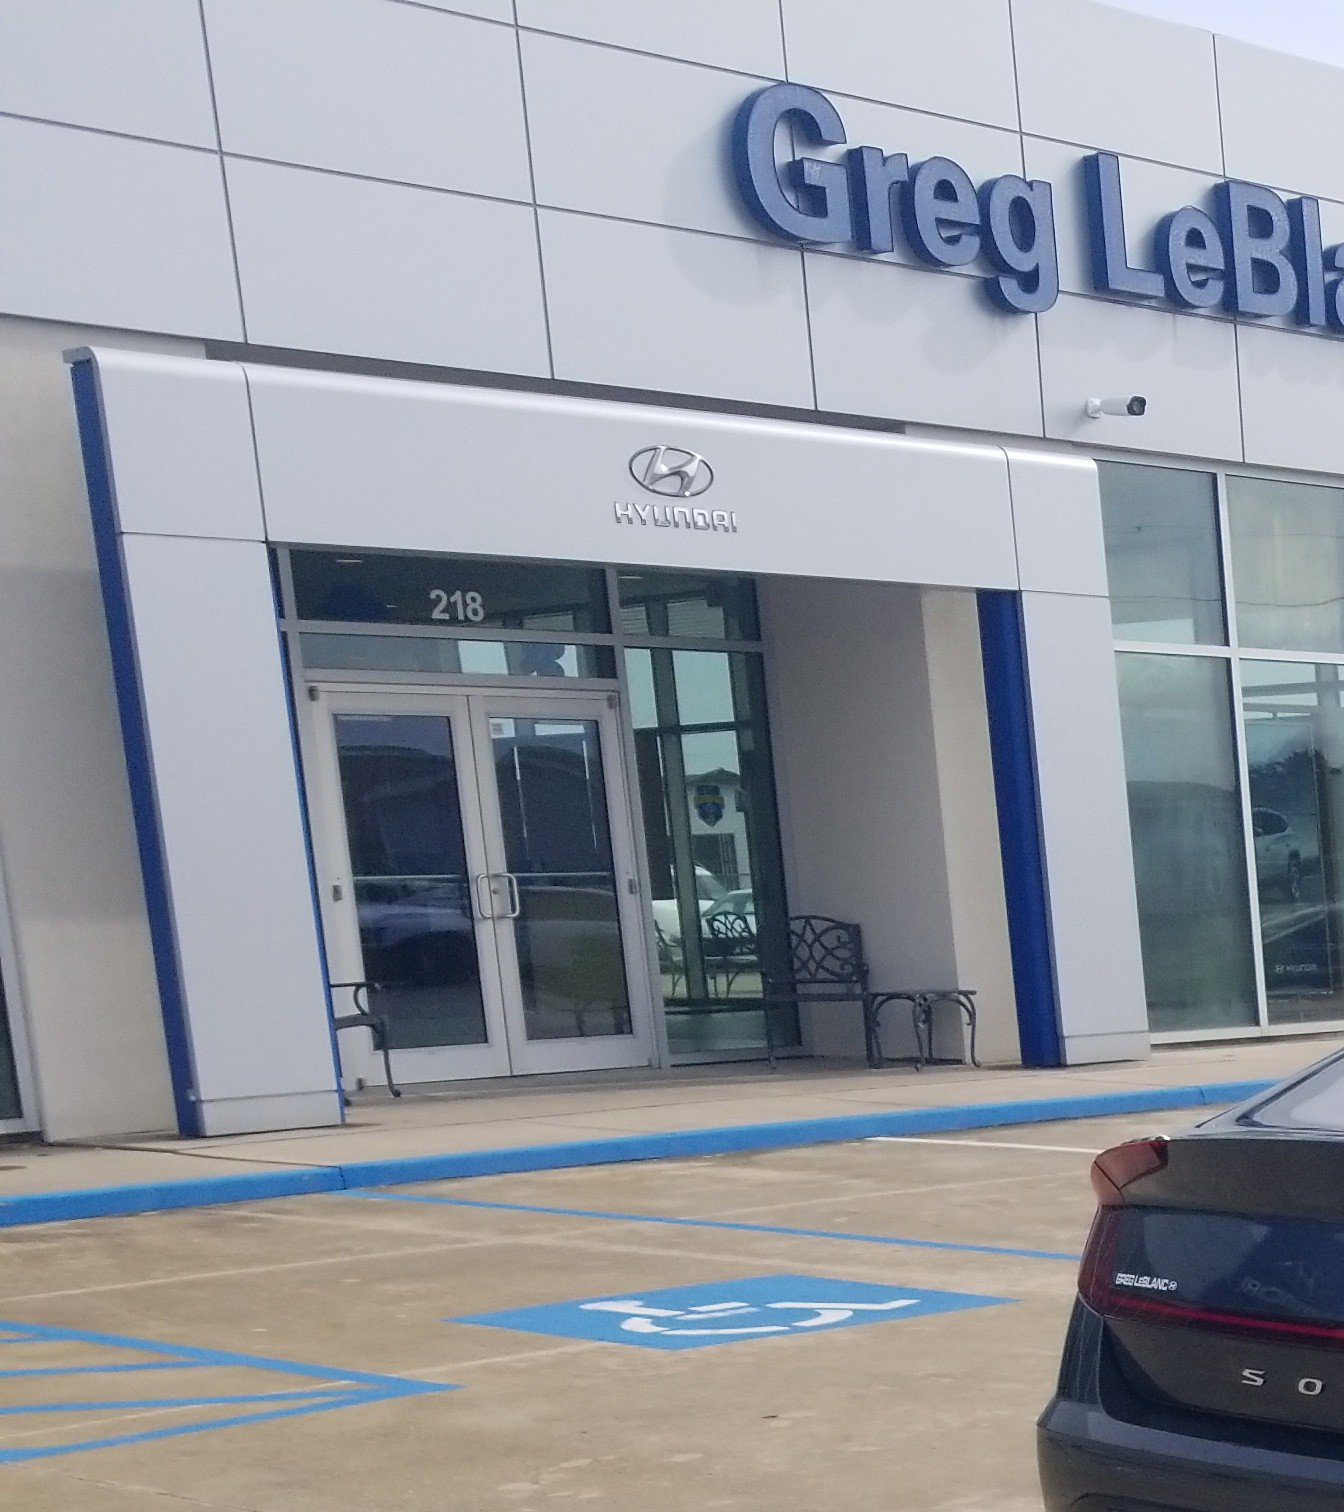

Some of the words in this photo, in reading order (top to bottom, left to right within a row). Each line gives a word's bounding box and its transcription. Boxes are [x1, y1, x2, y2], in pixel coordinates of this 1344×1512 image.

[732, 81, 1059, 314] Greg
[614, 501, 737, 533] HYUNDAI
[429, 589, 485, 622] 218
